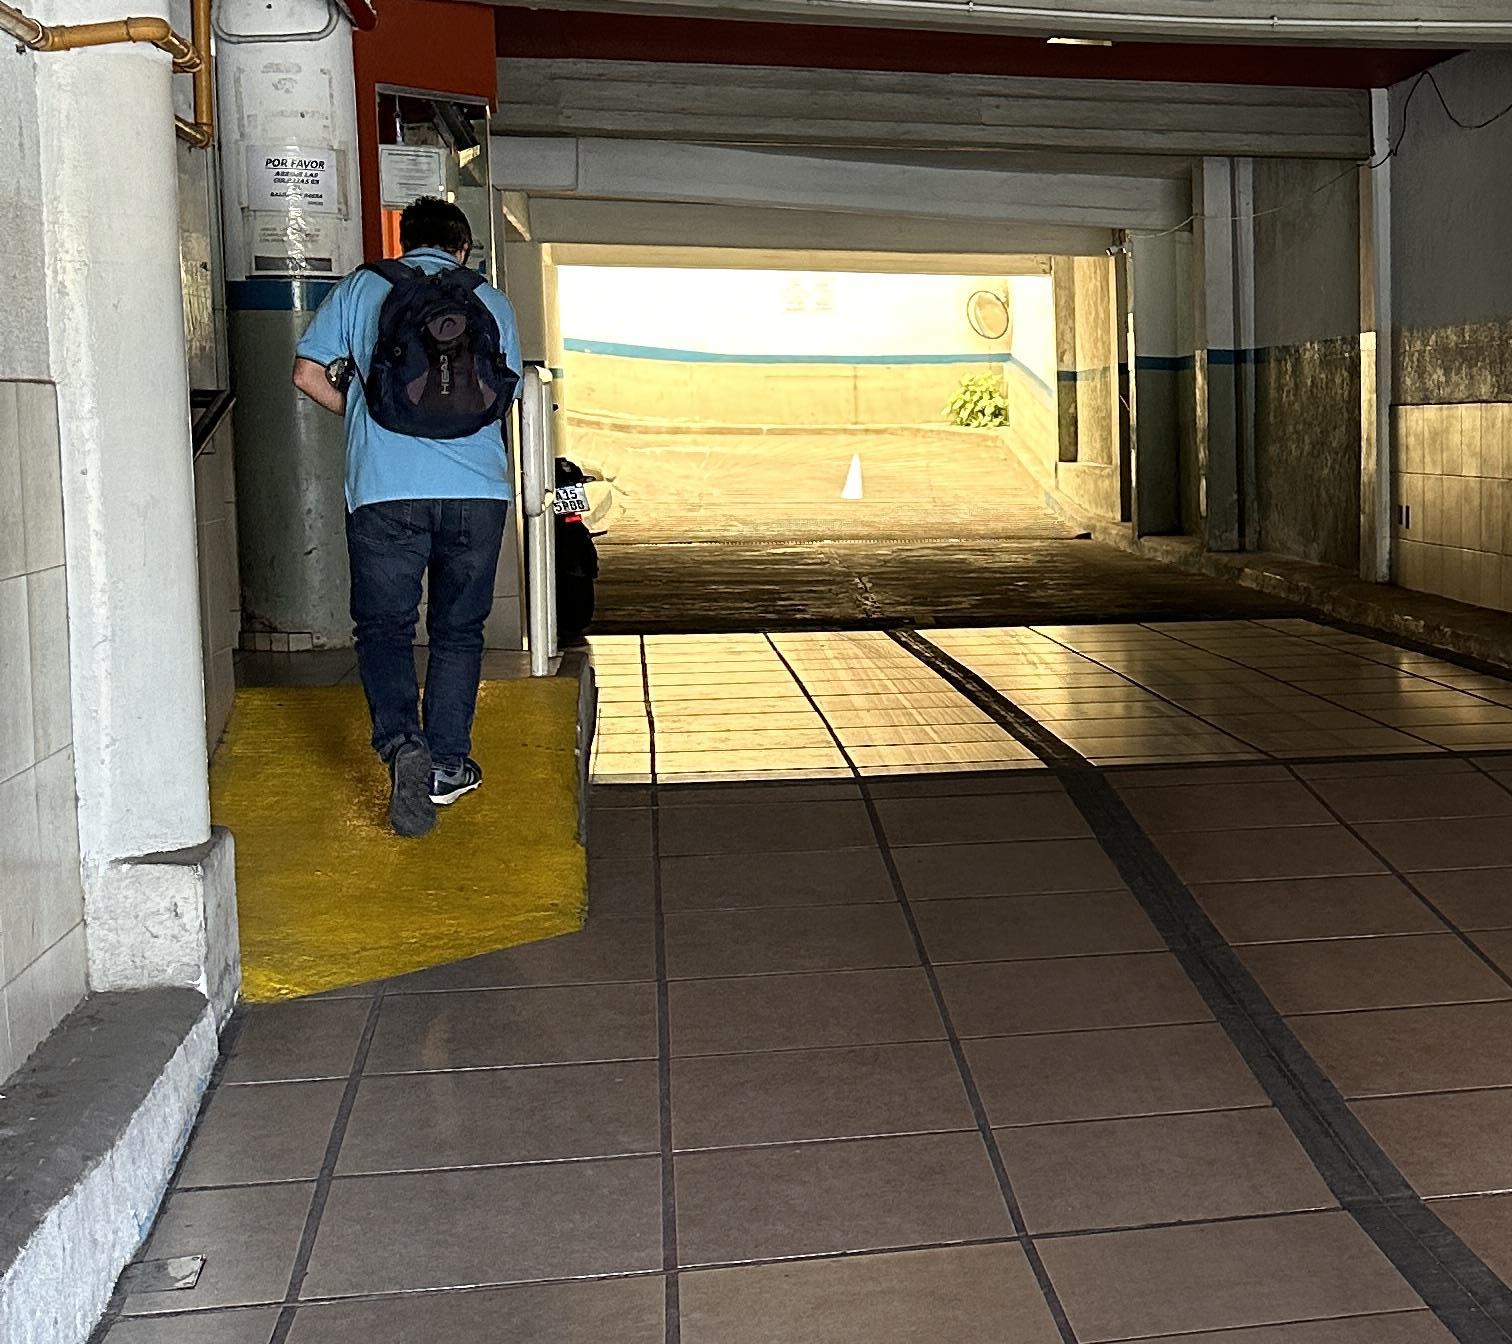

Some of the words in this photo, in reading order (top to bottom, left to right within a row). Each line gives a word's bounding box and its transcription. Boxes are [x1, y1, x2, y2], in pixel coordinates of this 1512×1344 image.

[265, 158, 288, 168] POR
[290, 159, 326, 170] FAVOR
[440, 355, 450, 395] HEAD
